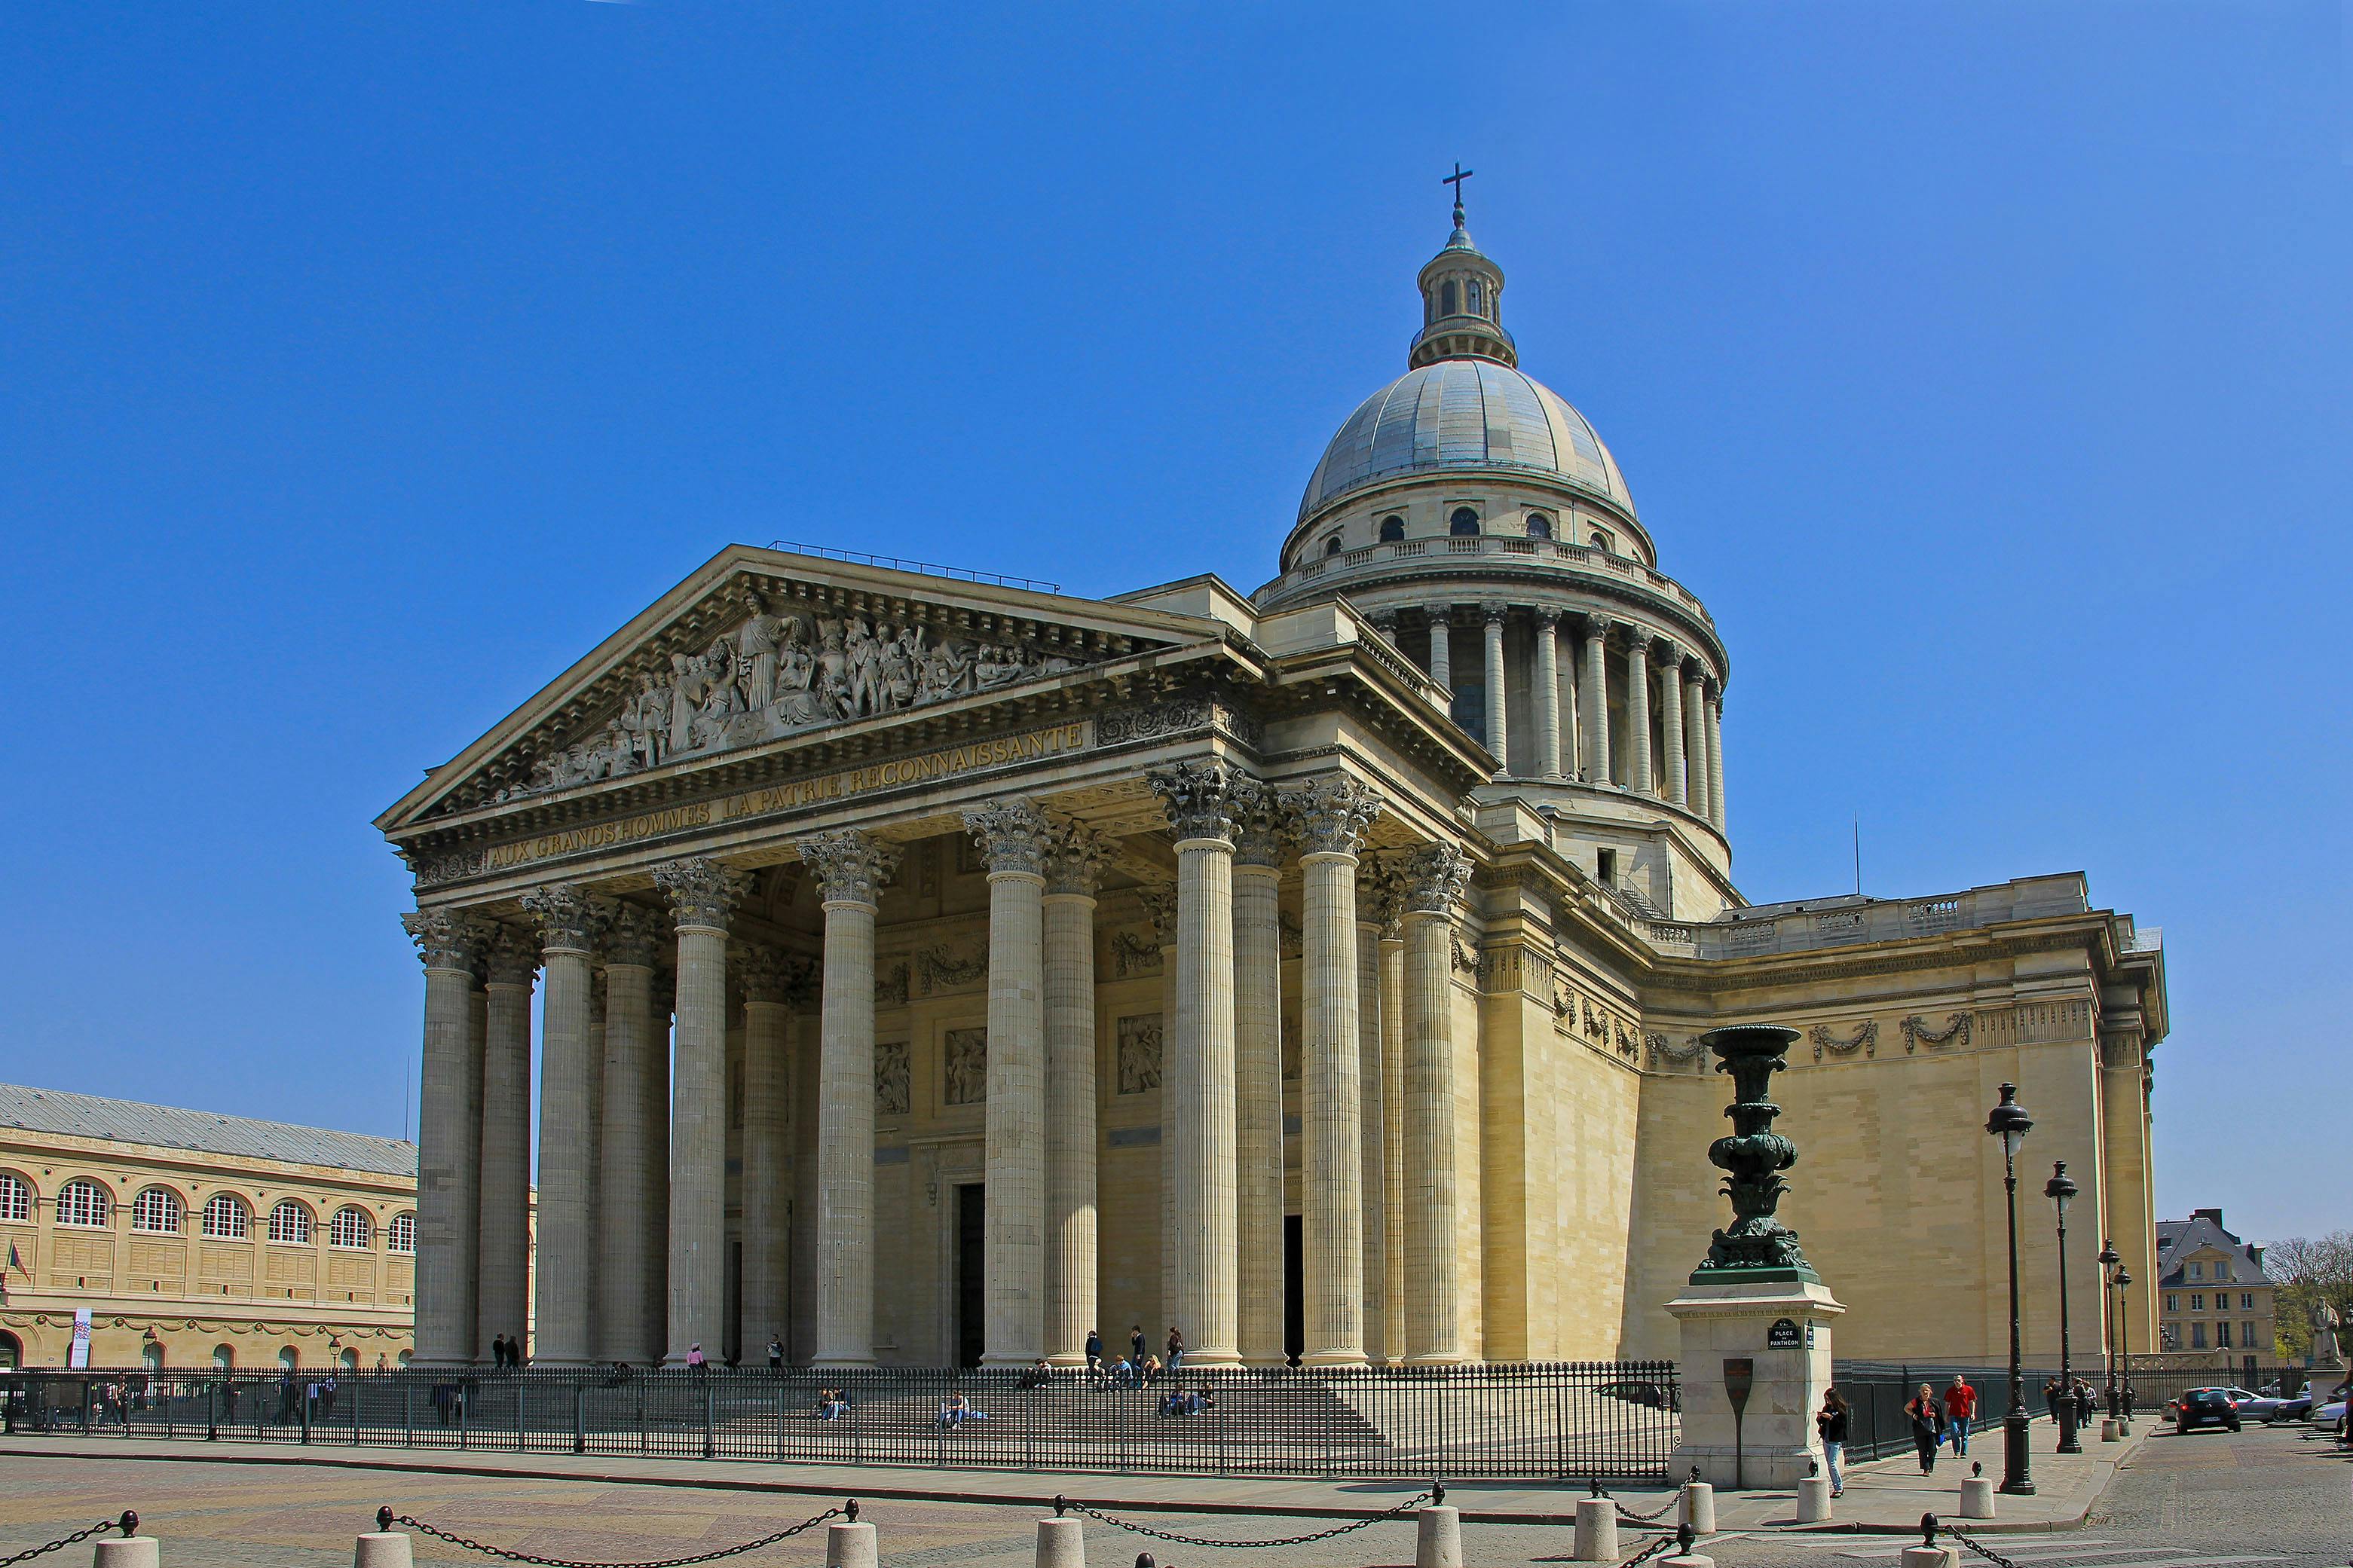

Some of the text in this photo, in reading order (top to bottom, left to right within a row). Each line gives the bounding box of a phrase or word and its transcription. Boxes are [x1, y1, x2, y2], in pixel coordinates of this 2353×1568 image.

[491, 723, 1084, 866] AUX GRANDS HOMMES LA PATRIE RECONNAISSANTE
